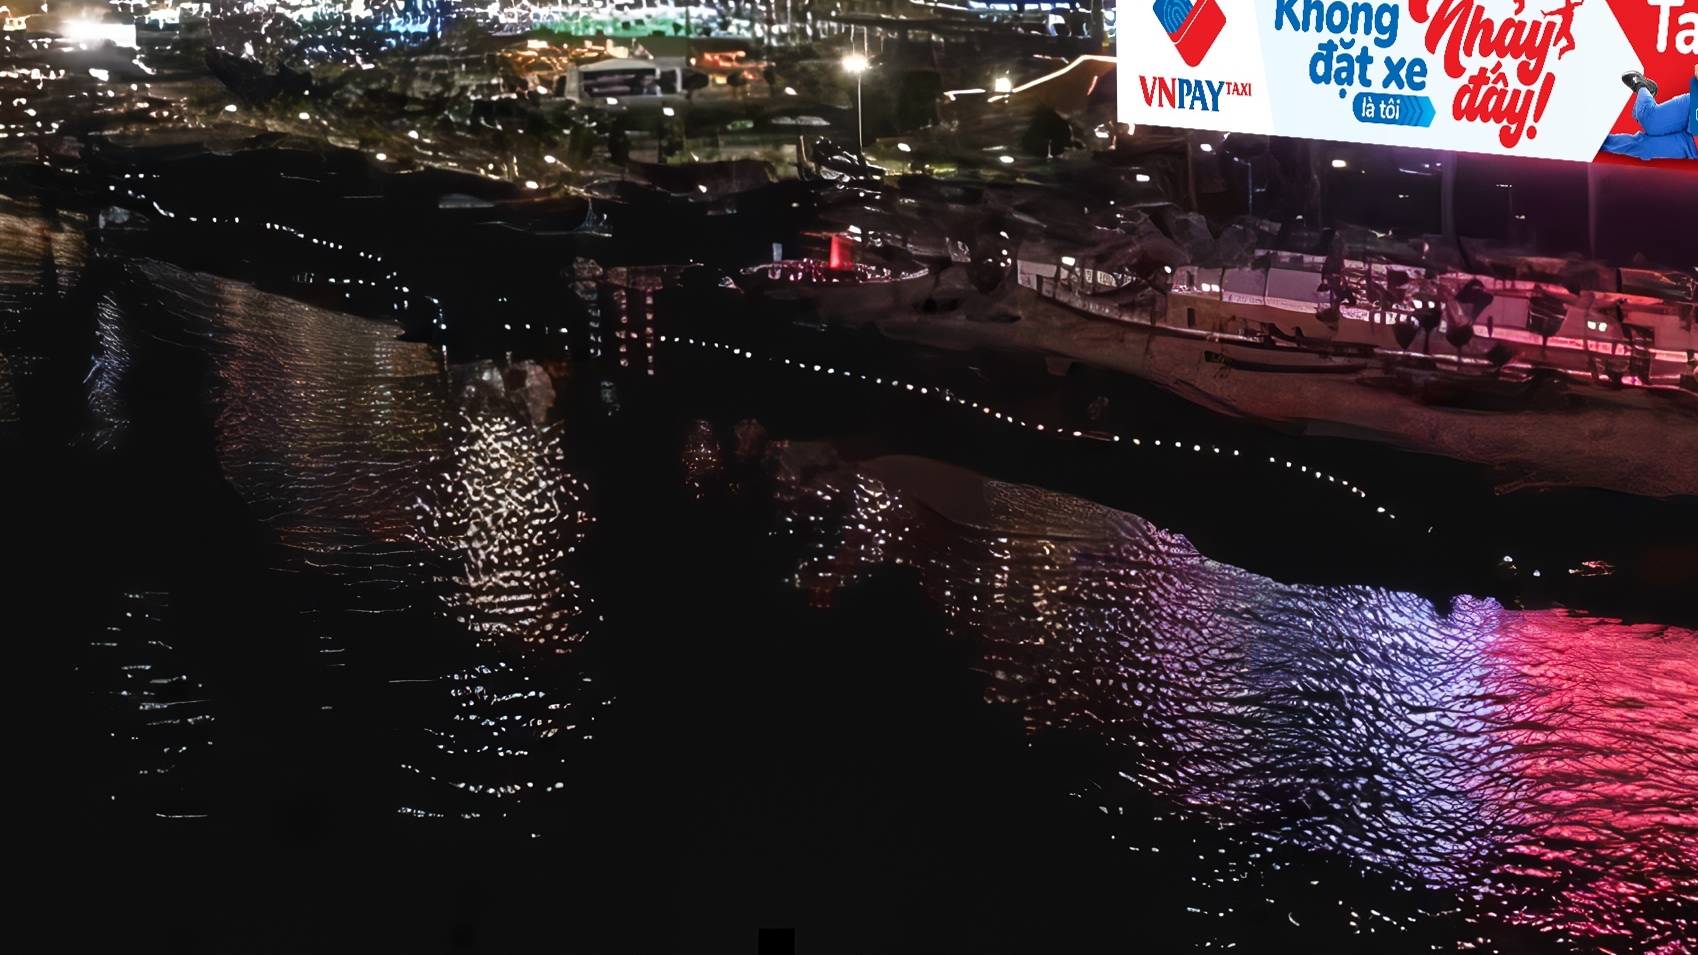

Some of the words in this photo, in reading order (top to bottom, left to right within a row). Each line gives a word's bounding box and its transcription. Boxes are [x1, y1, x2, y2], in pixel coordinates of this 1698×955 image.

[1309, 37, 1374, 99] đặt
[1382, 55, 1428, 92] xe
[1139, 75, 1225, 112] VNPAY
[1226, 81, 1252, 97] TAXI
[1361, 96, 1375, 118] là
[1379, 98, 1400, 120] tôi
[1452, 60, 1556, 149] đấy!
